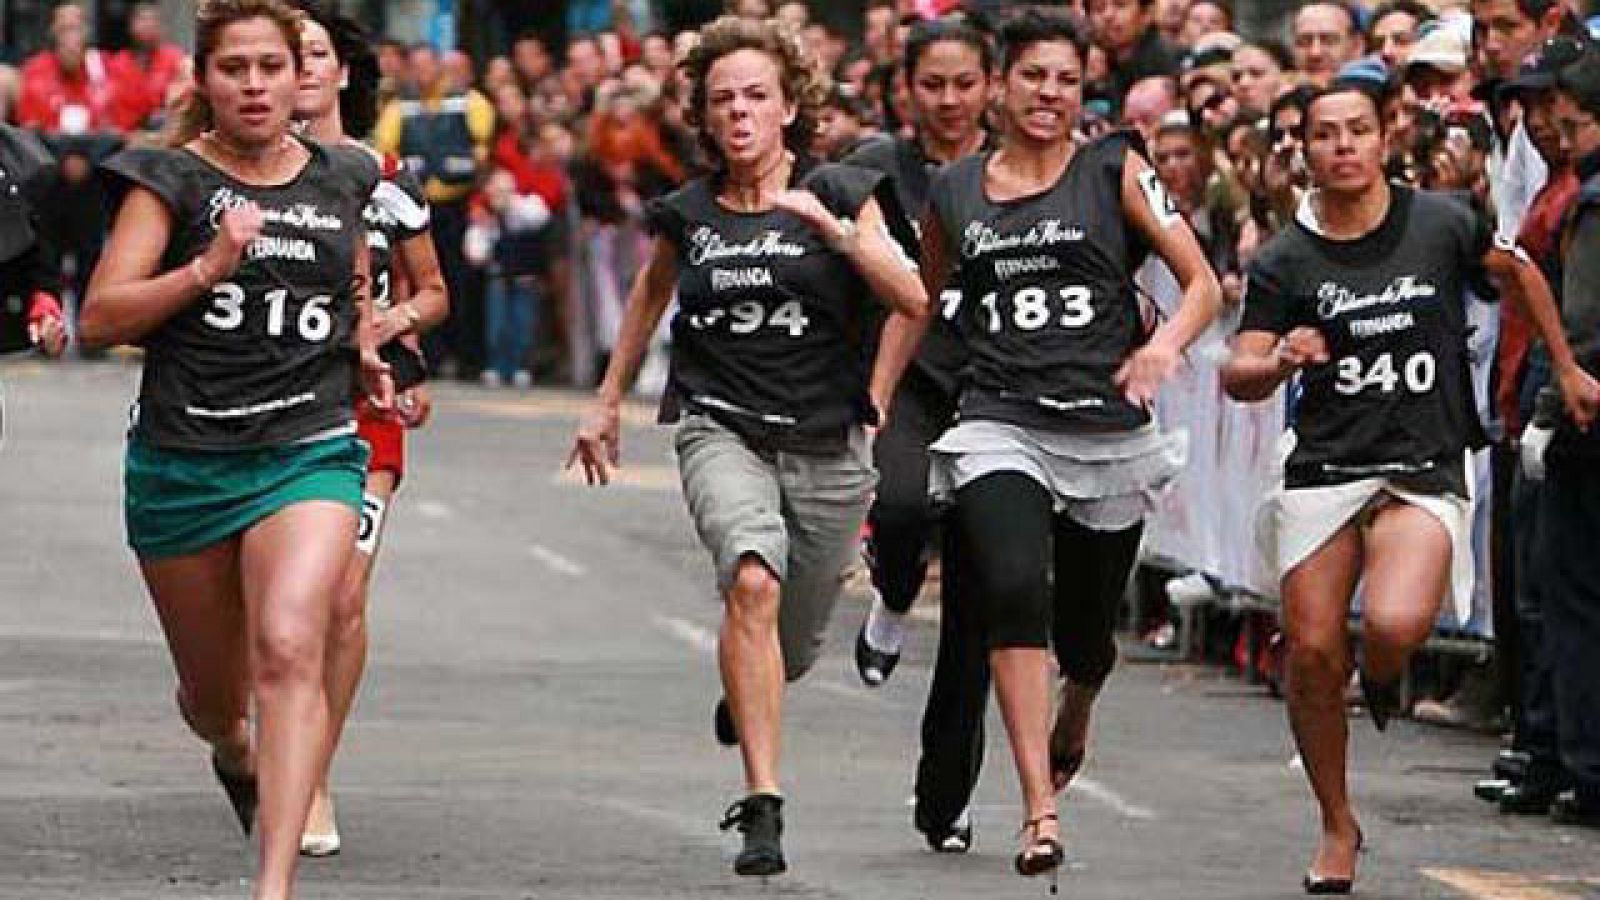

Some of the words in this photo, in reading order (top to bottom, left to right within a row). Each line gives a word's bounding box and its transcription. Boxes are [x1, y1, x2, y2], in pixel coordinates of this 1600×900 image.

[203, 281, 333, 341] 316
[981, 285, 1095, 333] 183
[1334, 352, 1436, 395] 340
